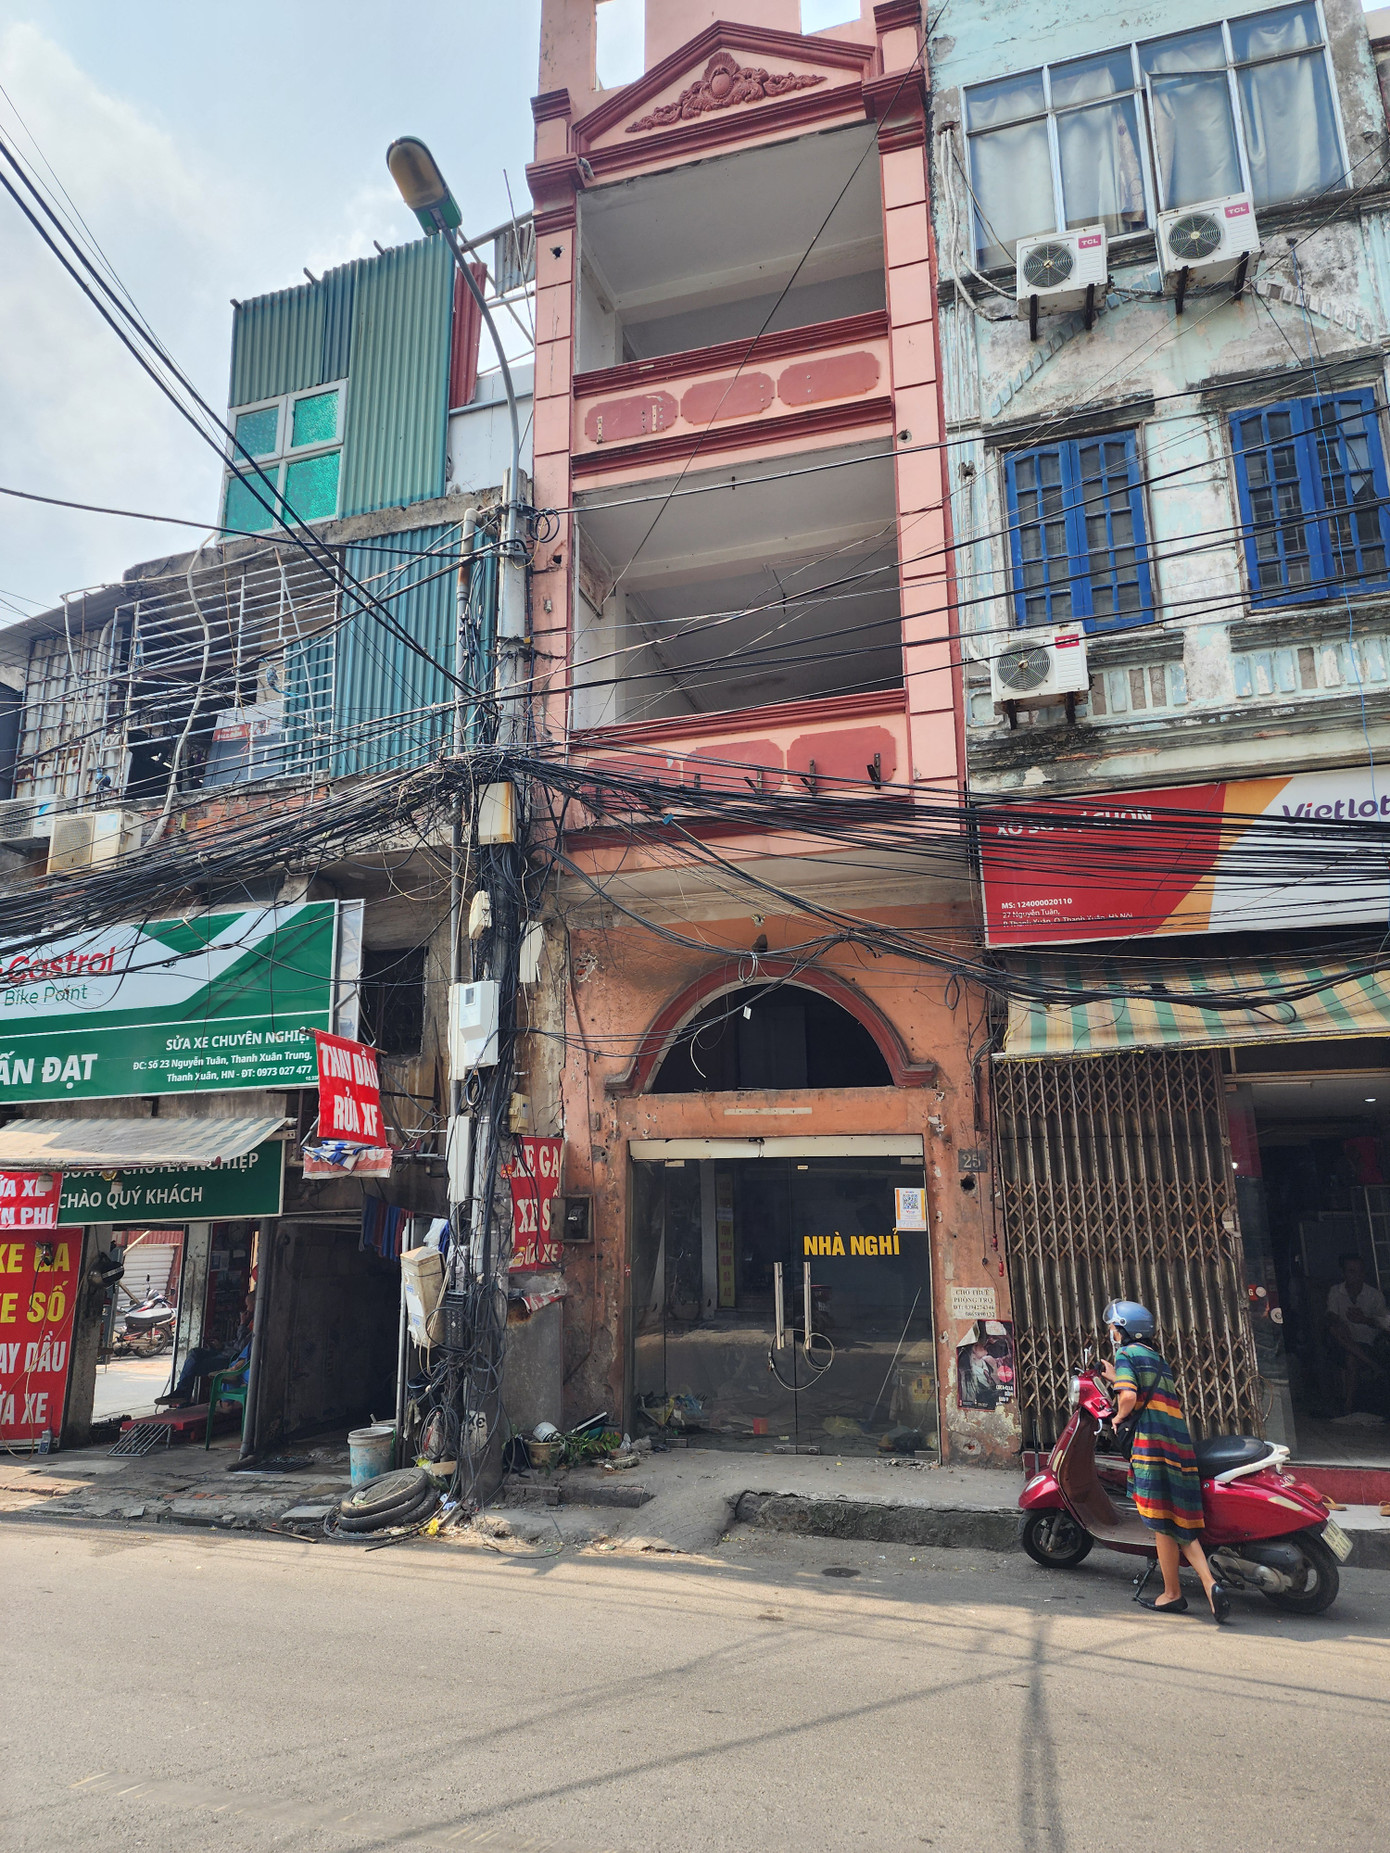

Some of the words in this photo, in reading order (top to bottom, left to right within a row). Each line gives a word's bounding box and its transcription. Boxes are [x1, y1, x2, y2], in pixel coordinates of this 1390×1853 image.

[1228, 206, 1247, 214] TCL
[1081, 238, 1098, 246] TCL
[8, 946, 116, 983] Castrol
[4, 988, 38, 1006] Bike
[44, 984, 88, 1003] Point
[166, 1034, 191, 1051] SỬA
[193, 1036, 209, 1048] XE
[211, 1030, 262, 1048] CHUYÊN
[42, 1054, 98, 1090] ĐẠT
[132, 1061, 147, 1070] ĐC:
[148, 1059, 158, 1069] Số
[160, 1060, 170, 1068] 23
[172, 1056, 204, 1070] Nguyễn
[206, 1056, 229, 1066] Tuân,
[230, 1054, 258, 1064] Thanh
[260, 1052, 282, 1062] Xuân
[284, 1050, 313, 1062] Trung,
[166, 1072, 193, 1082] Thanh
[194, 1072, 220, 1082] Xuân,
[221, 1070, 235, 1080] HN
[241, 1068, 256, 1078] ĐT:
[256, 1067, 278, 1077] 0973
[278, 1066, 295, 1076] 027
[296, 1065, 312, 1074] 477
[320, 1042, 352, 1081] THAY
[352, 1046, 380, 1090] DẦU
[333, 1086, 360, 1134] RỬA
[194, 1152, 259, 1173] HIỆP
[512, 1144, 536, 1178] XE
[538, 1144, 560, 1178] GA
[962, 1154, 981, 1168] 25
[60, 1188, 102, 1209] CHÀO
[106, 1183, 142, 1210] QUÝ
[146, 1183, 203, 1205] KHÁCH
[0, 1201, 15, 1225] N
[20, 1203, 54, 1225] PHÍ
[516, 1198, 538, 1234] XE
[541, 1244, 558, 1263] XE
[803, 1231, 846, 1256] NHÀ
[850, 1227, 900, 1256] NGHỈ
[0, 1293, 19, 1324] E
[26, 1280, 68, 1323] SỐ
[24, 1330, 66, 1372] DẦU
[20, 1392, 48, 1424] XE
